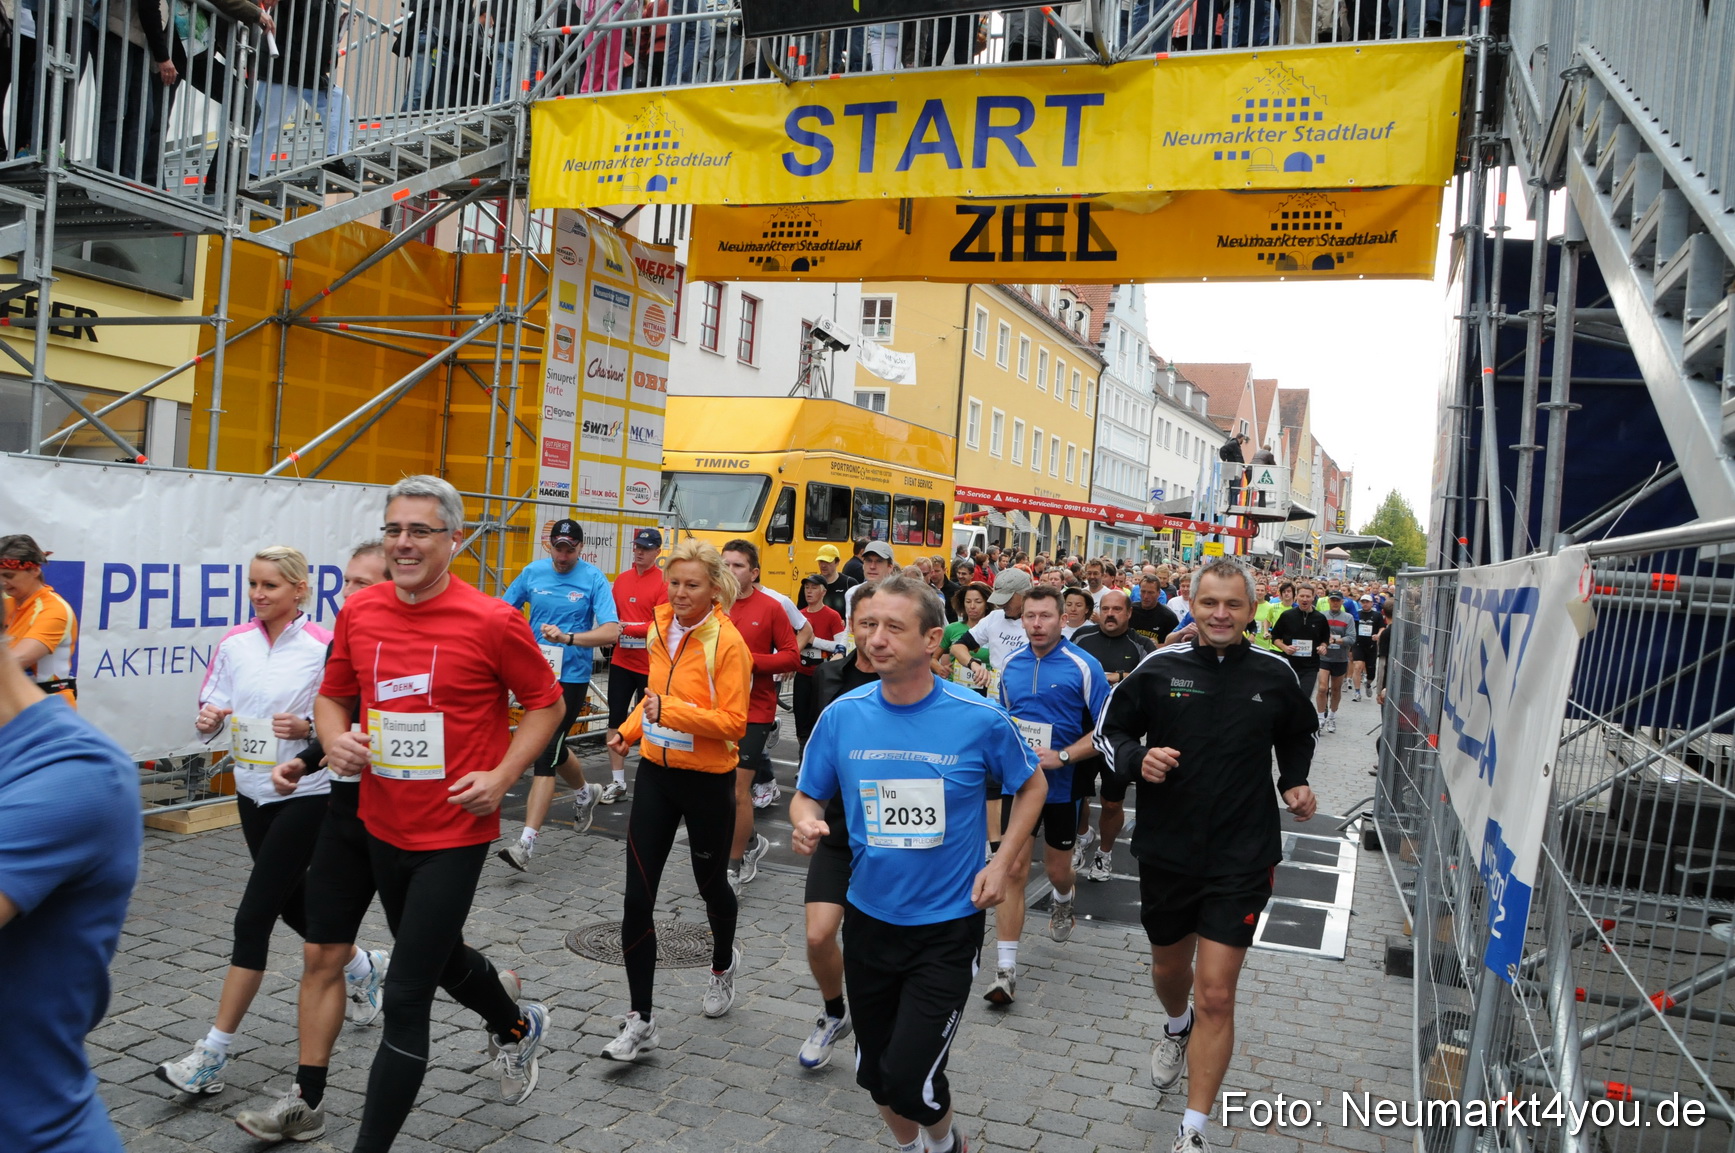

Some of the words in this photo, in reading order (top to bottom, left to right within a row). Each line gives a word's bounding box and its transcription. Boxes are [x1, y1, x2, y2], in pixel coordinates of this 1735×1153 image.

[781, 93, 1105, 177] START
[1163, 127, 1287, 148] Neumarkter
[1293, 122, 1395, 143] Stadtlauf
[563, 153, 652, 172] Neumarkter
[654, 151, 732, 168] Stadtlauf
[949, 202, 1117, 262] ZIEL
[1216, 234, 1314, 249] Neumarkter
[1317, 230, 1398, 246] Stadtlauf
[718, 240, 797, 253] Neumarkter
[799, 238, 862, 252] Stadtlauf
[635, 257, 676, 280] MERZ
[560, 301, 574, 312] KANN
[547, 368, 576, 386] Sinupret
[634, 370, 668, 393] OBI
[546, 382, 563, 396] forte
[582, 420, 608, 436] swn
[630, 425, 654, 442] MCM
[695, 458, 750, 469] TIMING
[831, 461, 860, 474] SPORTRONIC
[544, 480, 570, 489] INTERSPORT
[626, 485, 647, 493] GERHART
[904, 476, 917, 487] EVENT
[918, 479, 933, 490] SERVICE
[539, 488, 569, 498] HACKNER
[604, 489, 618, 498] BÖGL
[967, 490, 991, 499] Service
[1005, 496, 1021, 504] Miet-
[1028, 499, 1063, 509] Serviceline:
[1082, 506, 1097, 514] 6352
[583, 532, 612, 549] inupret
[93, 645, 212, 679] AKTIEN
[392, 682, 414, 693] DEHN
[1170, 677, 1194, 688] team
[383, 717, 426, 732] Raimund
[242, 738, 267, 754] 327
[390, 739, 429, 758] 232
[887, 752, 928, 762] saller
[882, 786, 897, 799] Ivo
[866, 805, 872, 815] C
[884, 807, 937, 826] 2033
